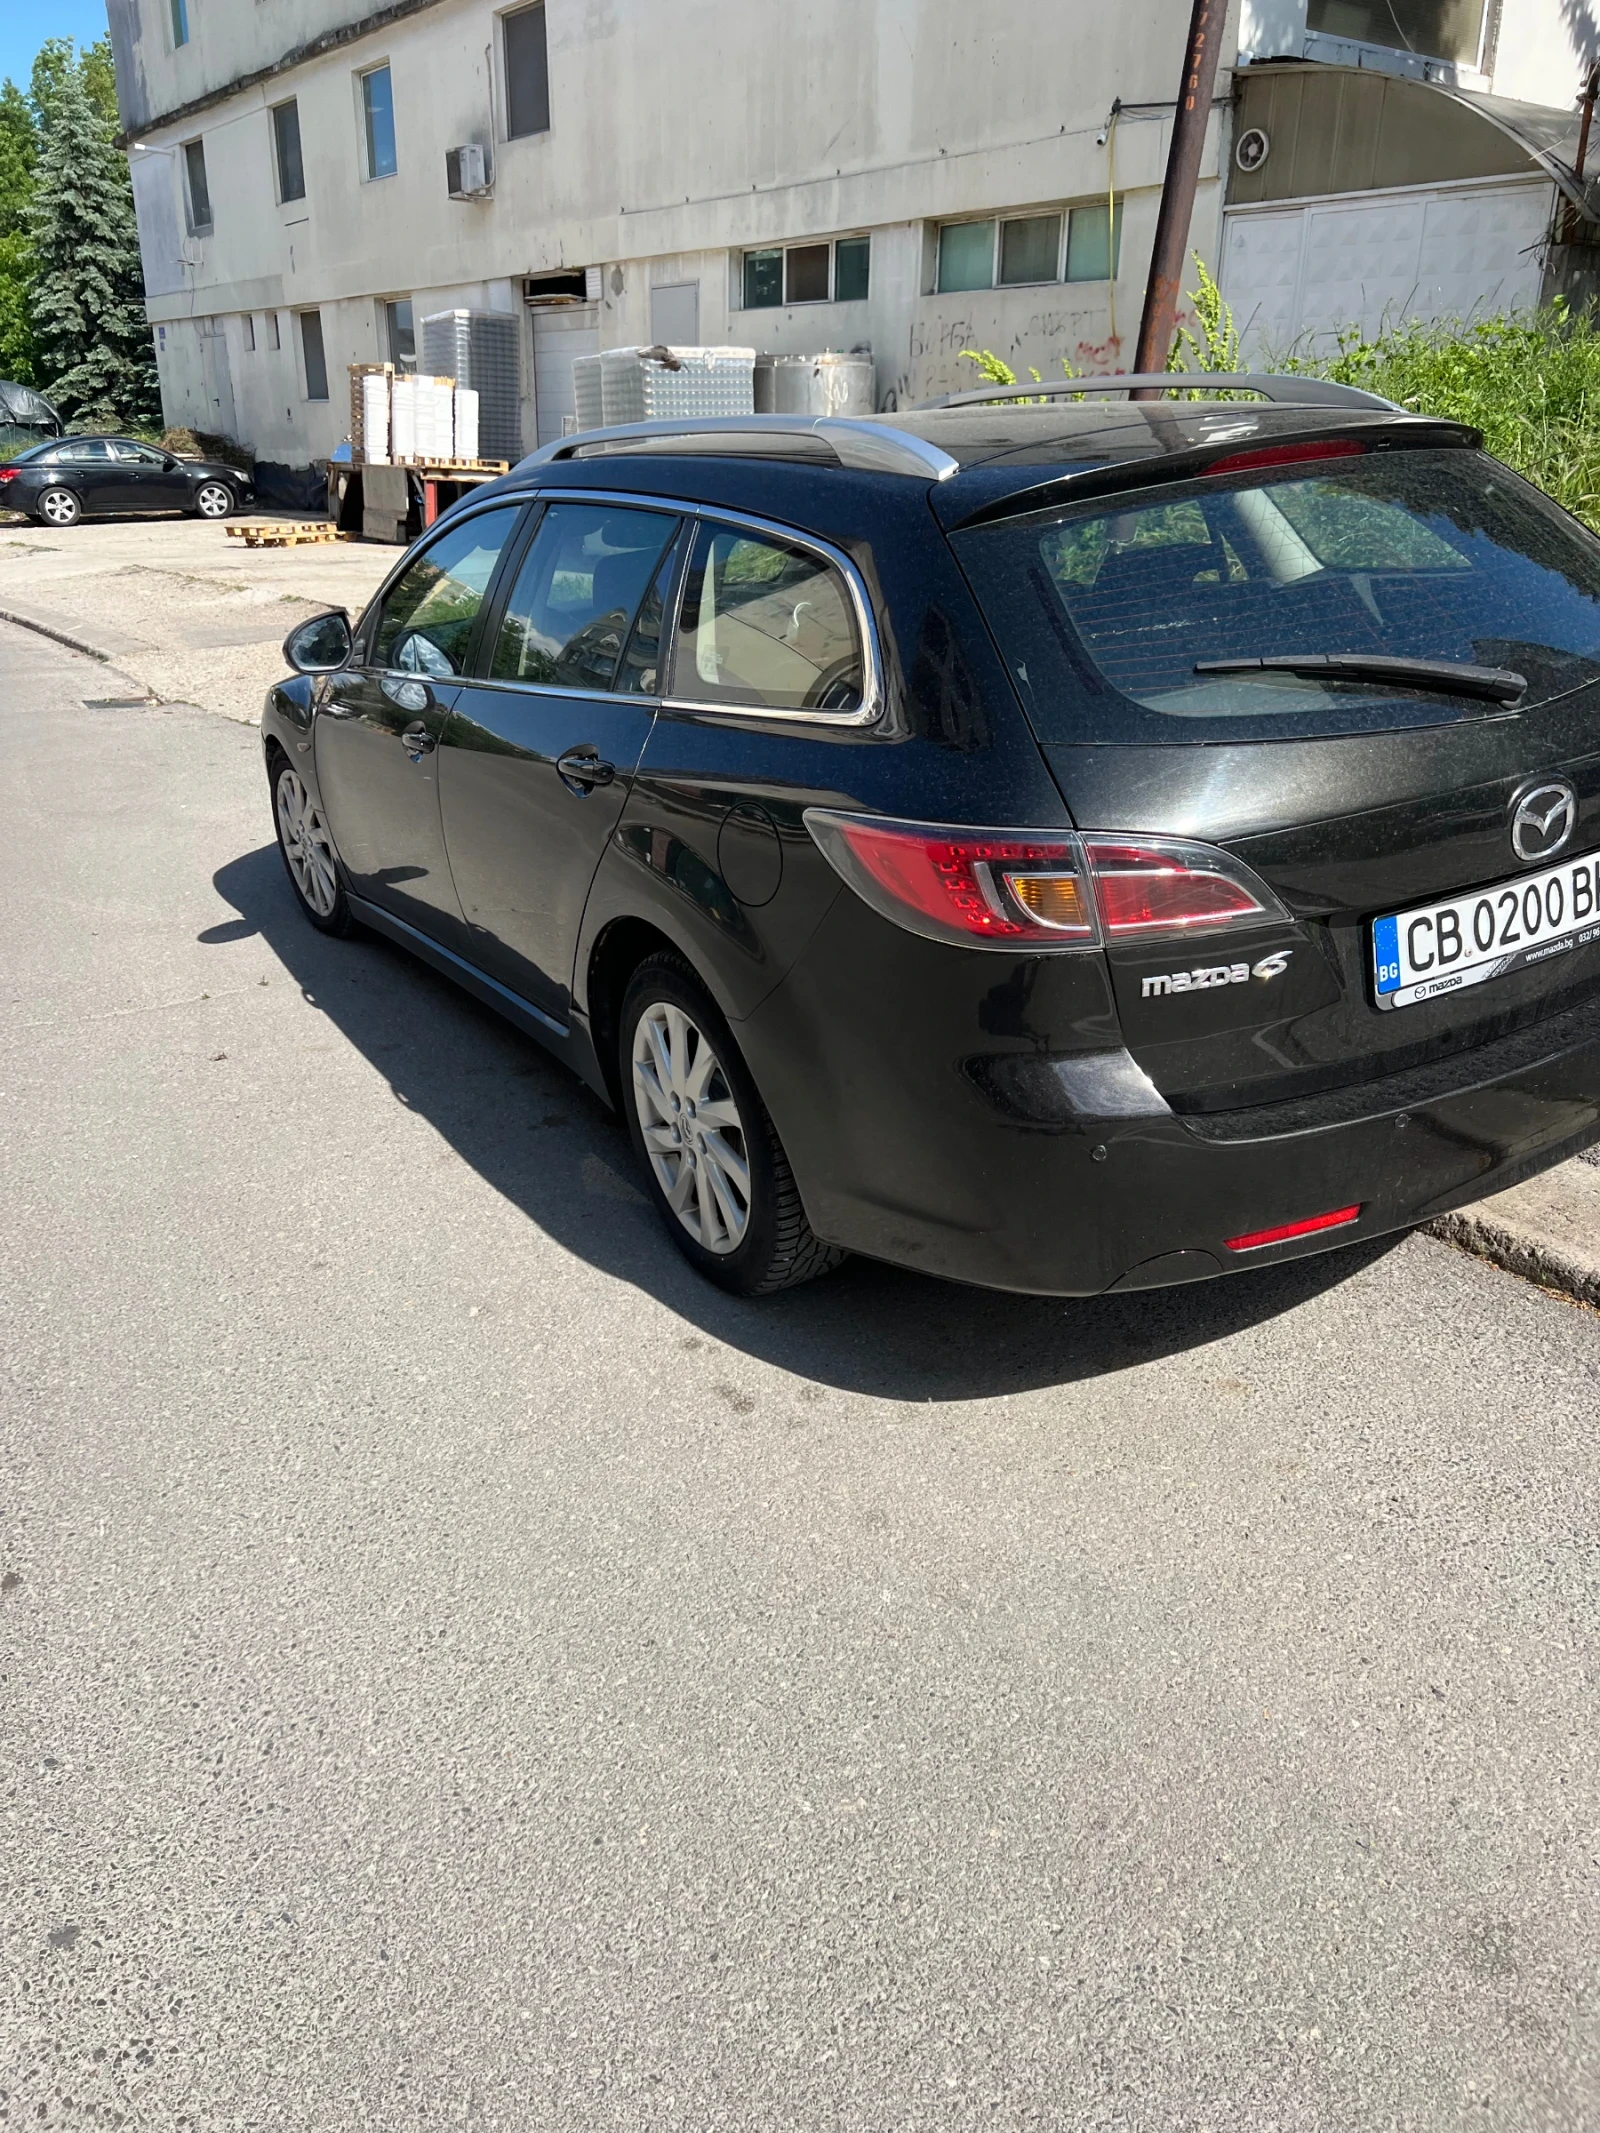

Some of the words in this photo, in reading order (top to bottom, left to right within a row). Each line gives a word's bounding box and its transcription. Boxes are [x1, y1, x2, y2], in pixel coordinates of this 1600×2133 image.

[1408, 909, 1463, 972] CB
[1474, 877, 1564, 952] 0200
[1572, 861, 1600, 920] B
[1525, 939, 1573, 962] www.mazda.bg
[1380, 962, 1398, 983] BG
[1429, 976, 1463, 994] mazda
